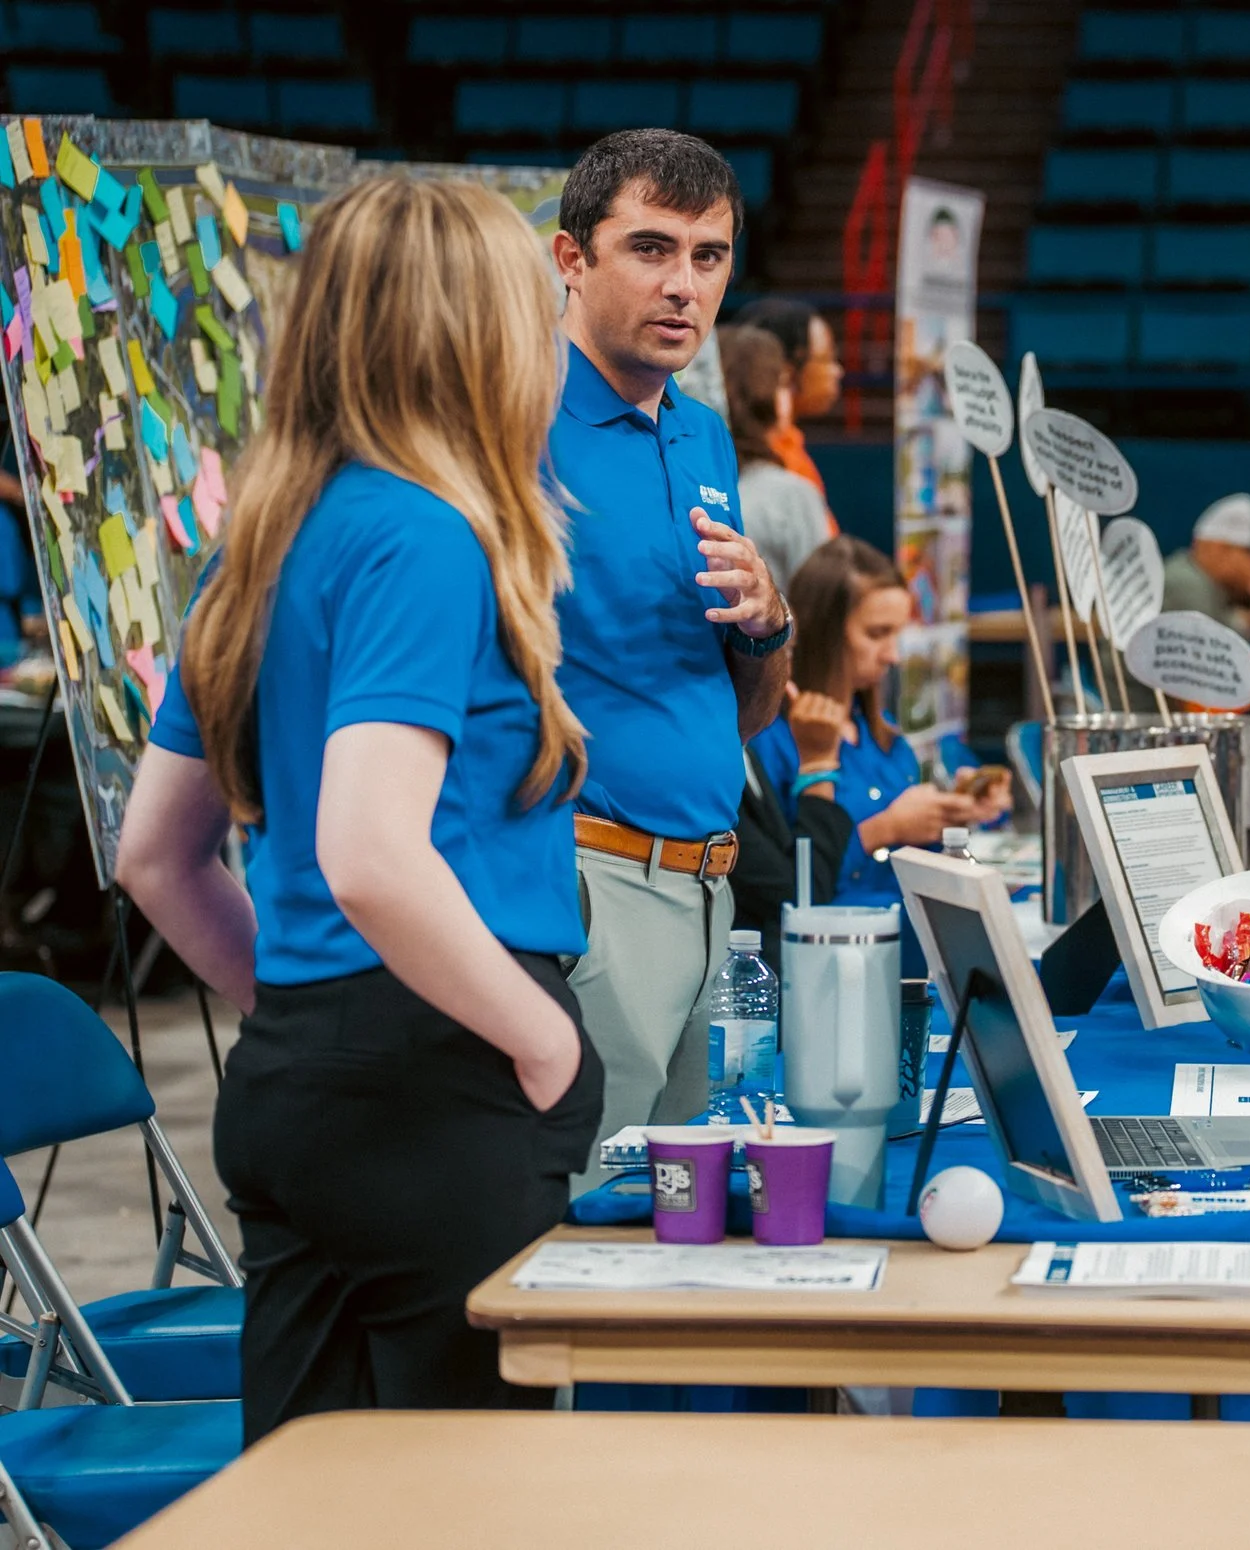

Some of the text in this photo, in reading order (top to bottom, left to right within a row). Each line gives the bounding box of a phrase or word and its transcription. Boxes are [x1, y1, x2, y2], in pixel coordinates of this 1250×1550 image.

[1157, 627, 1232, 652] Ensure the
[1155, 644, 1186, 656] park
